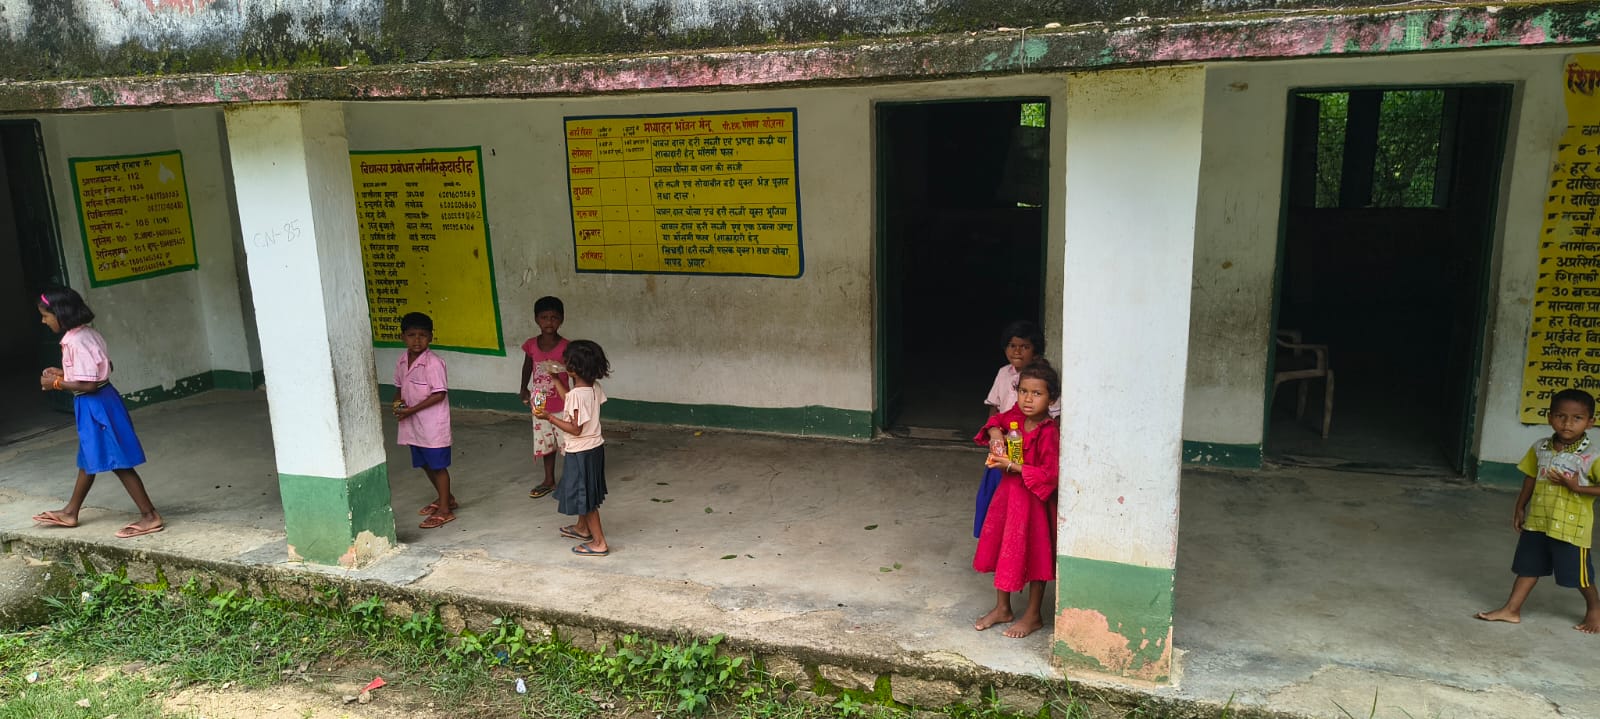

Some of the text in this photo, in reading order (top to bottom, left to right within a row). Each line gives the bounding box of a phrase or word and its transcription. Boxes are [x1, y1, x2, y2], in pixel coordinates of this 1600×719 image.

[1570, 161, 1591, 177] हर
[1552, 286, 1568, 297] 30
[1548, 301, 1586, 313] मान्यता
[1548, 315, 1565, 328] हर
[1541, 343, 1582, 358] प्रतिशत
[1537, 375, 1569, 389] सदस्य
